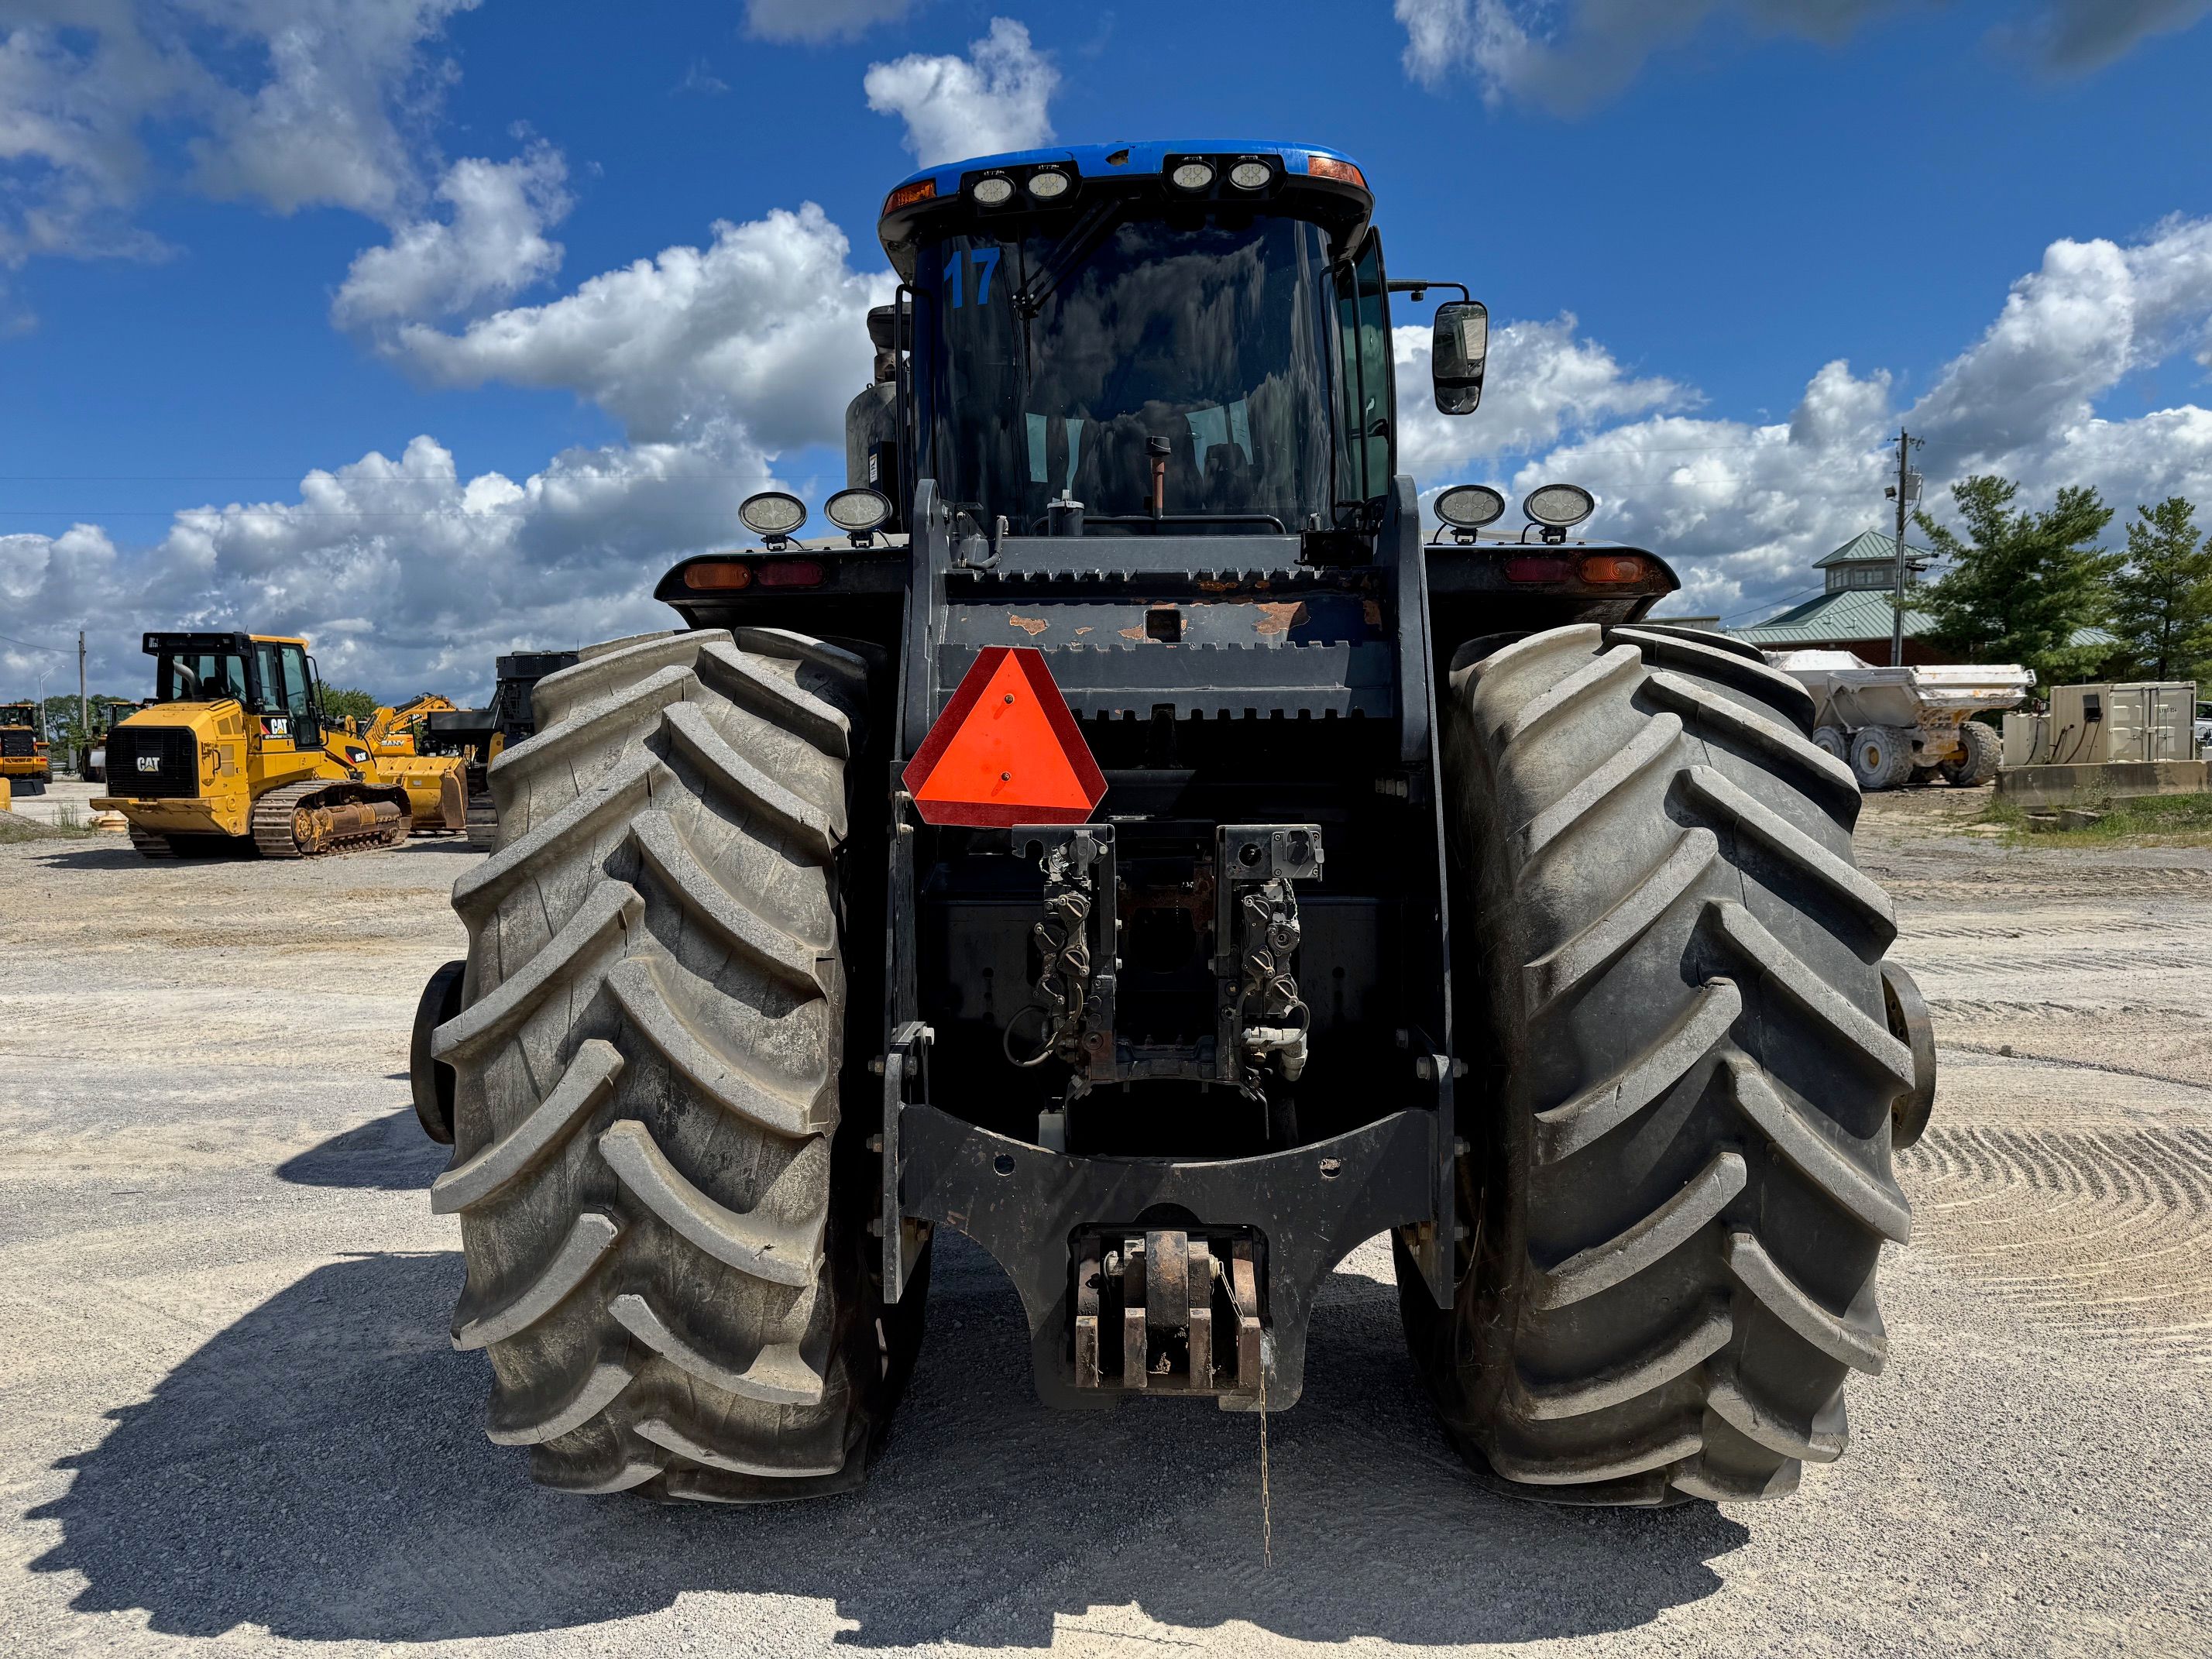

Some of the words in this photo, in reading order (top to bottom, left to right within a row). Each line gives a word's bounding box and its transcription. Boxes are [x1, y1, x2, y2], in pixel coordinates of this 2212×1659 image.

[943, 247, 1001, 309] 17
[271, 718, 287, 734] CAT
[137, 757, 160, 772] CAT
